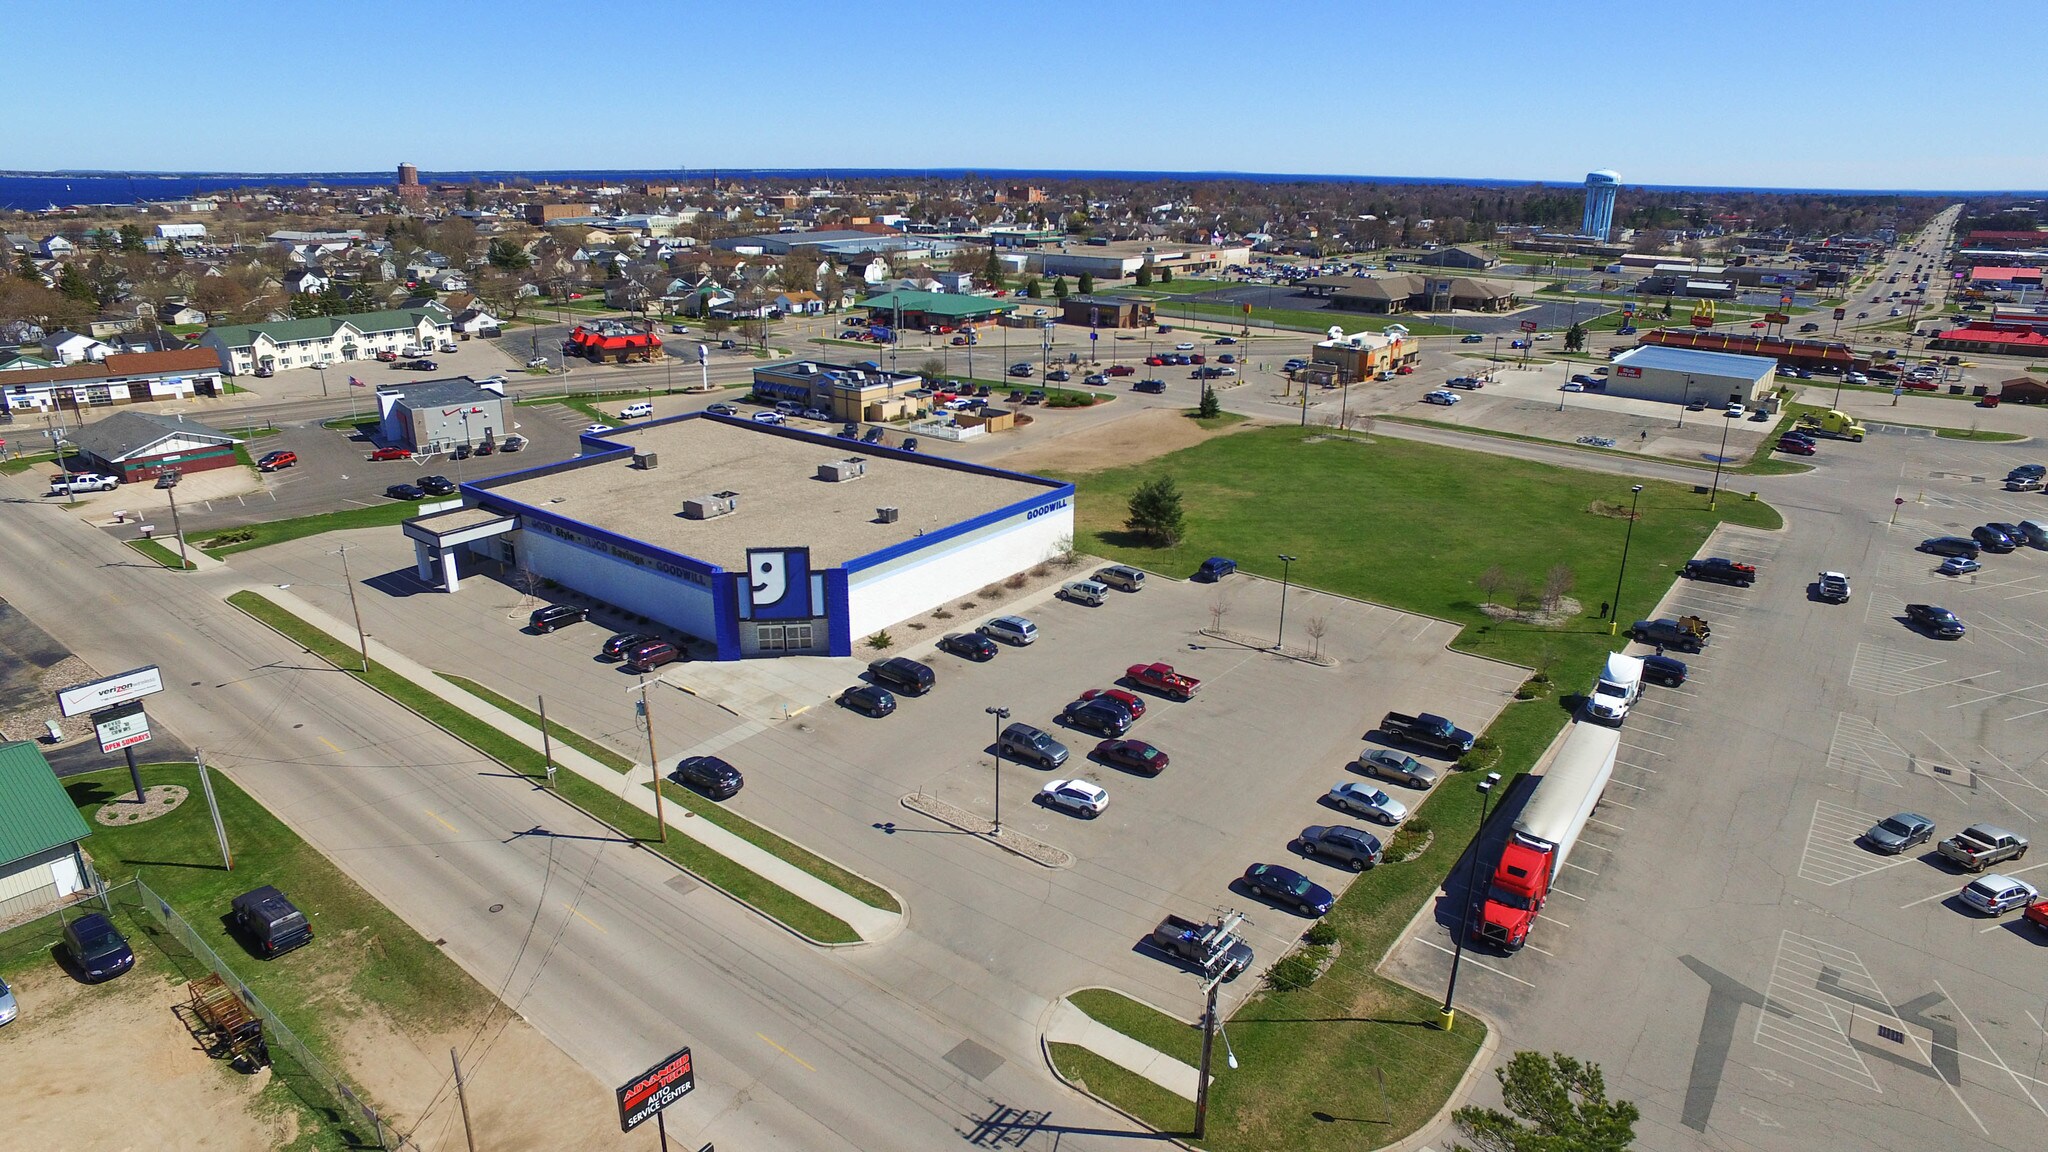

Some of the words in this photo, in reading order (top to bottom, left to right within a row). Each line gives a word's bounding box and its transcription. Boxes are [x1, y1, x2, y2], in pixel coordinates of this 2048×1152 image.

[1027, 499, 1067, 520] GOODWILL
[555, 526, 574, 541] Style
[656, 561, 706, 586] GOODWILL
[98, 682, 133, 696] verizon
[104, 741, 122, 752] OPEN
[121, 732, 150, 746] SUNDAYS
[624, 1053, 690, 1102] ADVANCED
[658, 1062, 691, 1087] TECH
[628, 1101, 661, 1127] SERVICE
[661, 1081, 692, 1105] CENTER
[647, 1085, 671, 1106] AUTO
